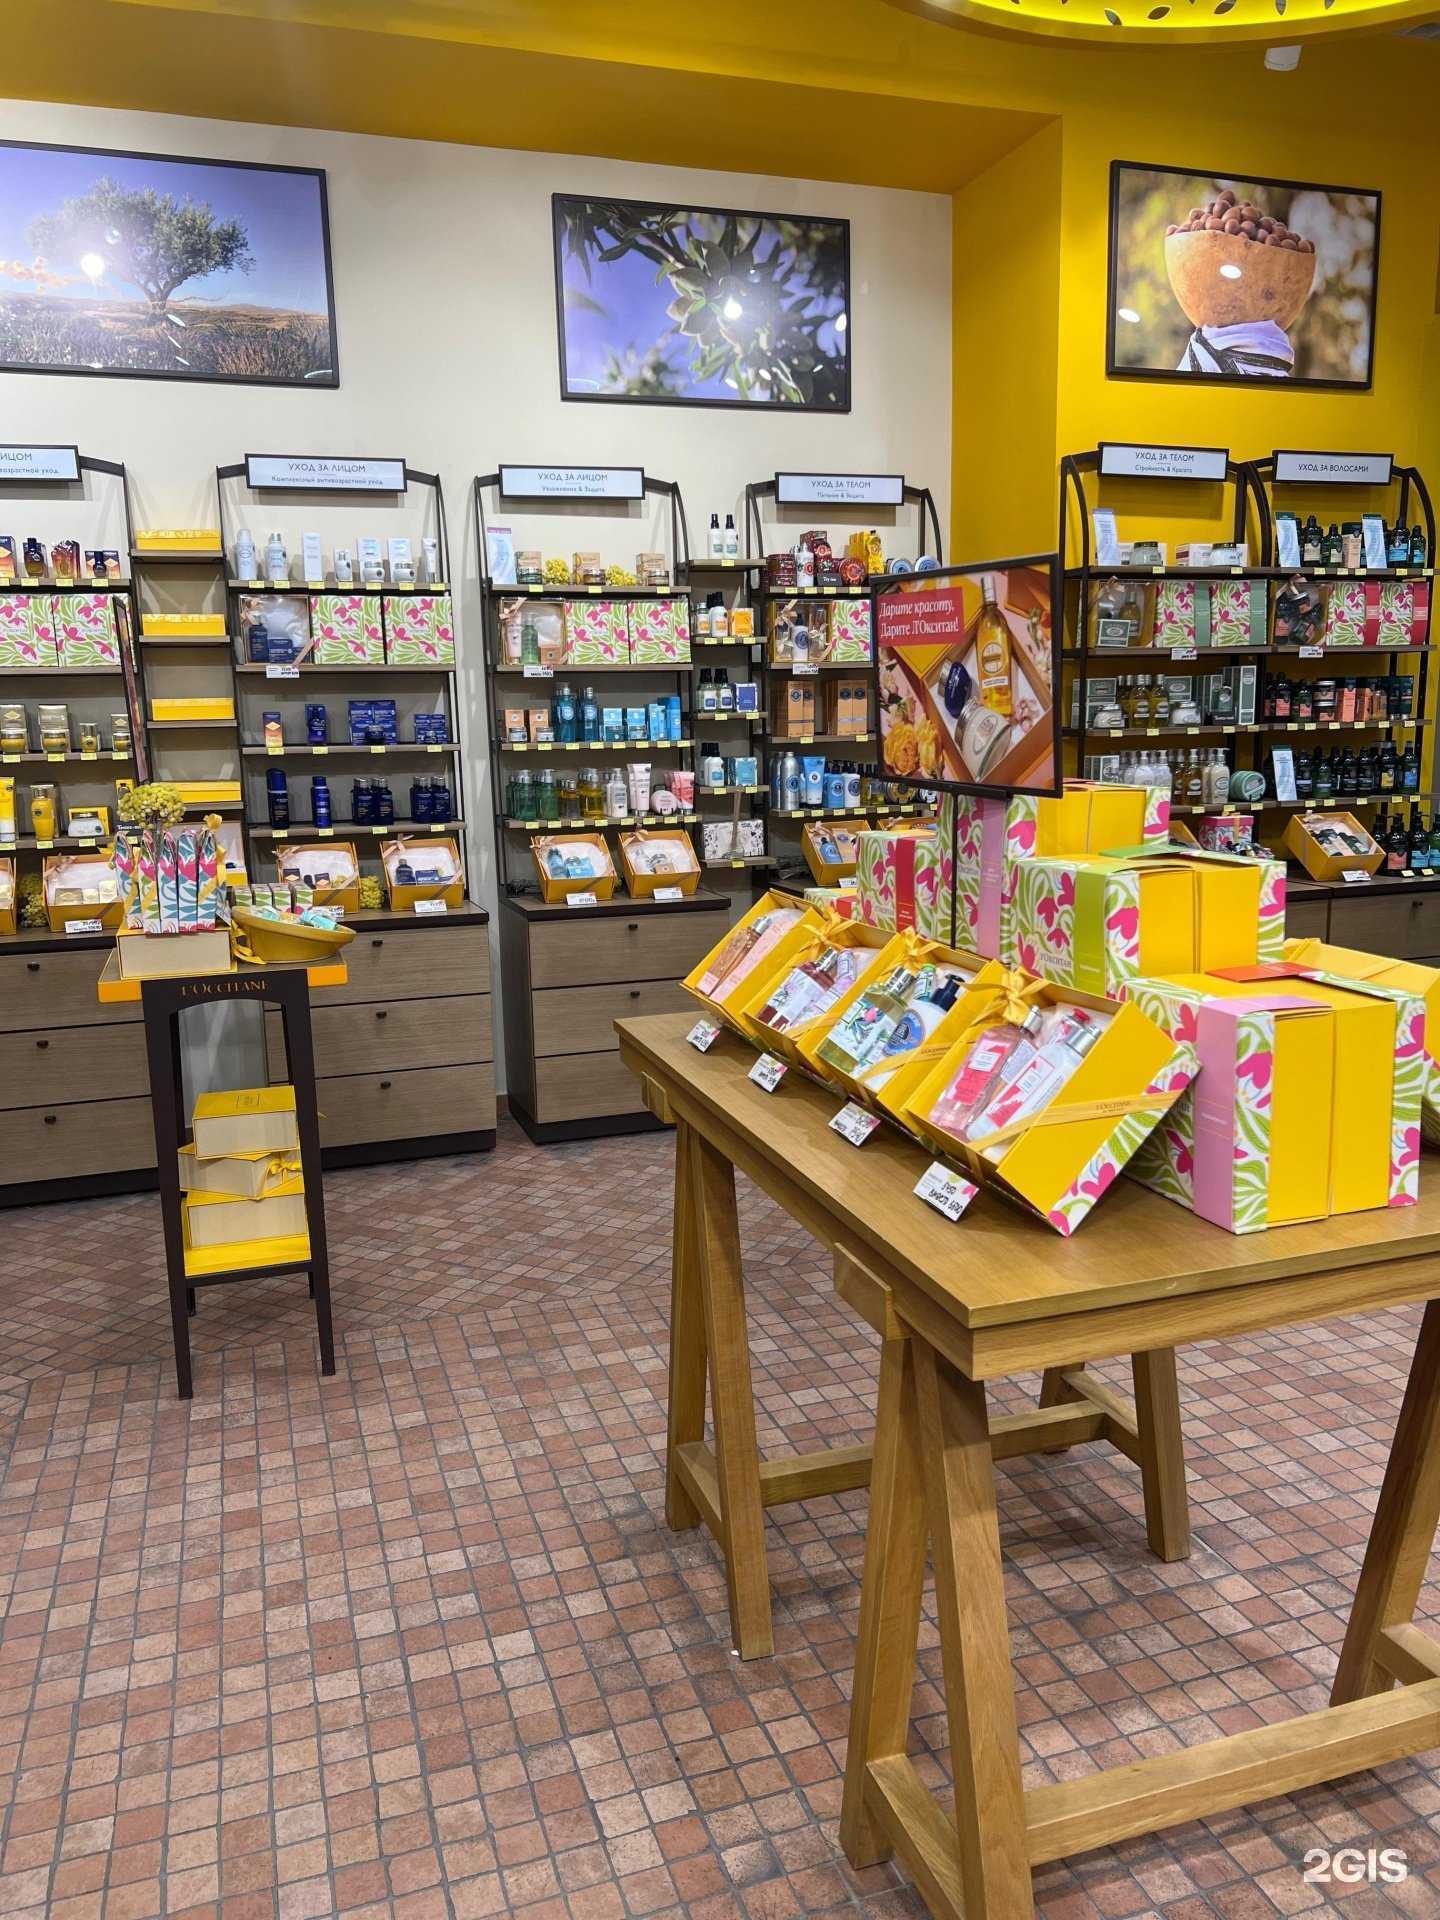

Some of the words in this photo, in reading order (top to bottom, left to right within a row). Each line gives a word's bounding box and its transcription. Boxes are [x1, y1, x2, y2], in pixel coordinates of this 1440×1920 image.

[1135, 452, 1156, 460] УХОД
[1159, 453, 1167, 461] ЗА
[1170, 453, 1194, 462] ТЕЛОМ
[289, 463, 316, 472] УХОД
[318, 463, 329, 472] ЗА
[332, 464, 366, 473] ЛИЦОМ
[1298, 464, 1318, 472] УХОД
[1320, 464, 1328, 472] ЗА
[1329, 464, 1369, 473] ВОЛОСАМИ
[538, 472, 562, 481] УХОД
[565, 473, 574, 481] ЗА
[577, 473, 608, 482] ЛИЦОМ
[811, 480, 833, 489] УХОД
[835, 481, 844, 489] ЗА
[846, 481, 871, 489] ТЕЛОМ
[879, 602, 913, 619] Дарите
[880, 623, 911, 640] Дарите
[912, 616, 959, 635] Л'Окситан!
